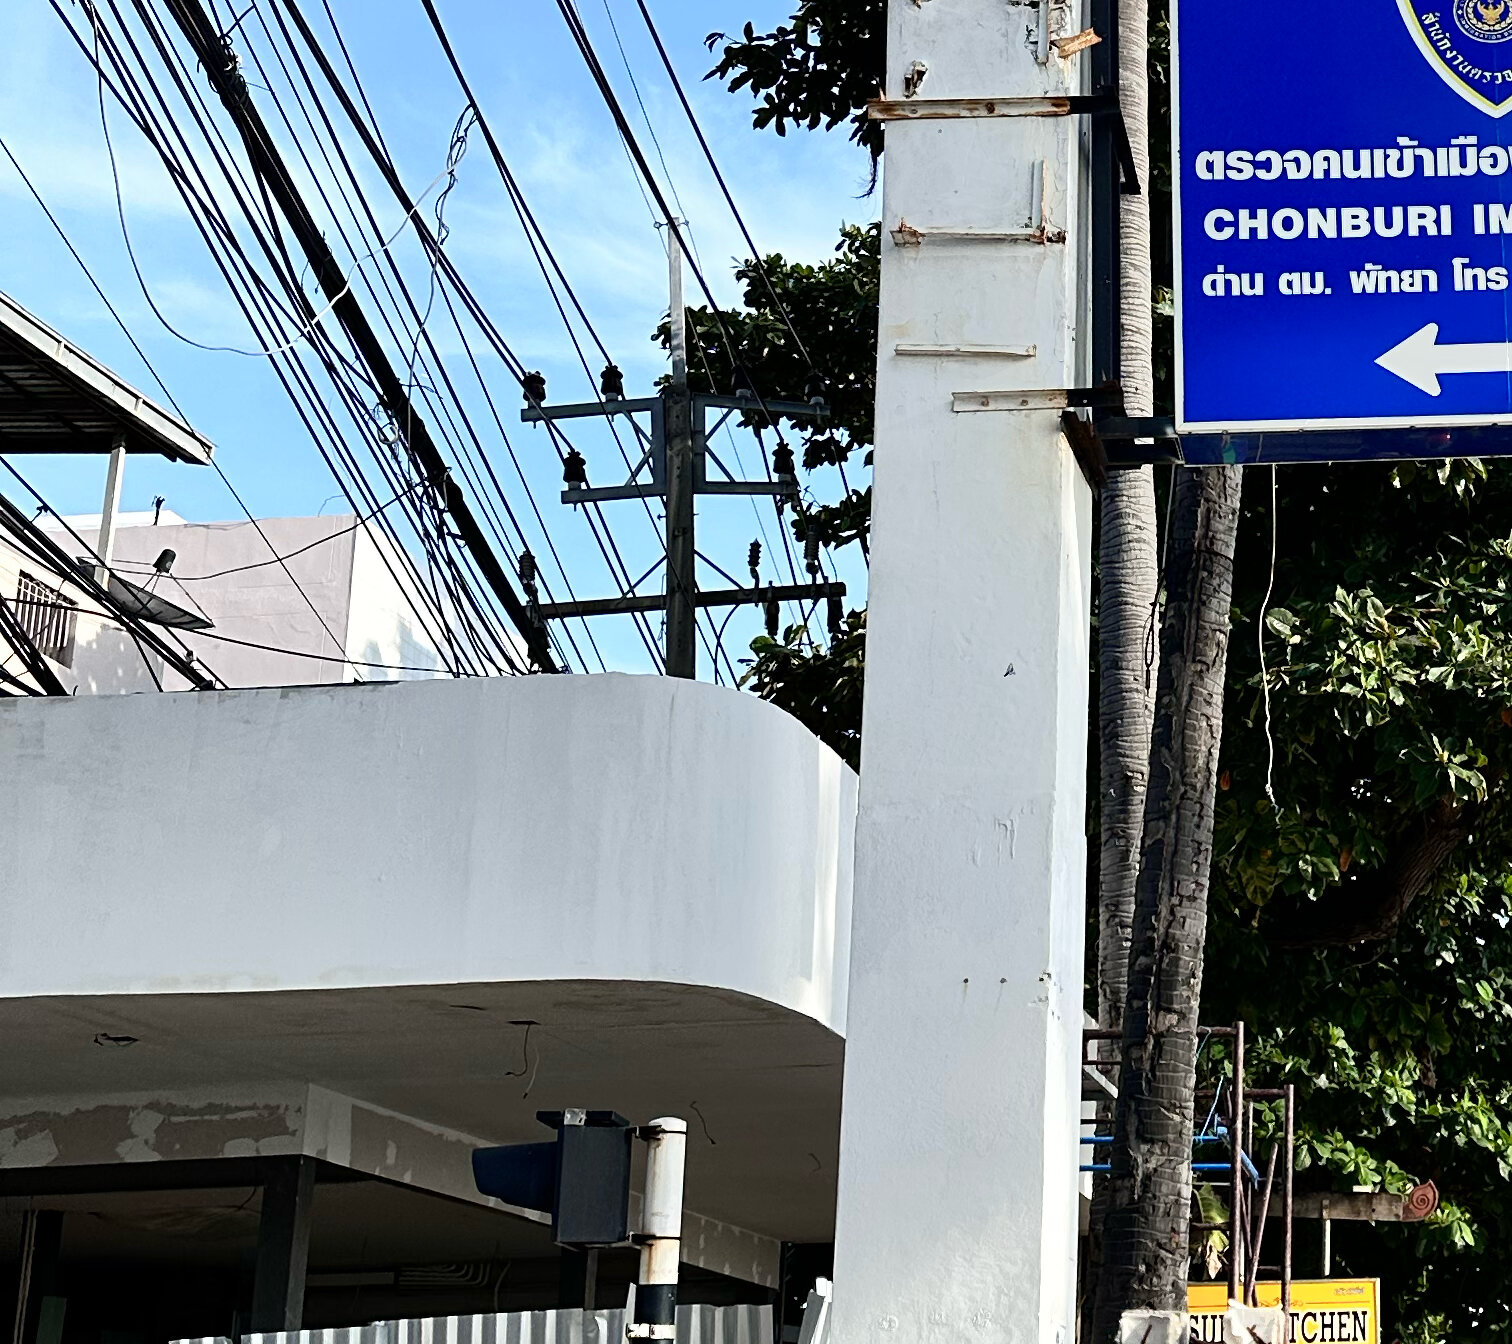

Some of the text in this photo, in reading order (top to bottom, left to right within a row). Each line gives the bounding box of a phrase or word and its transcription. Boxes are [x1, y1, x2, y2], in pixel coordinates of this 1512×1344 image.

[1203, 204, 1452, 241] CHONBURI
[1202, 264, 1264, 297] ด่าน
[1278, 271, 1332, 295] ตม.
[1349, 262, 1438, 294] พัทยา
[1452, 257, 1509, 292] โทร
[1288, 1310, 1368, 1344] TCHEN
